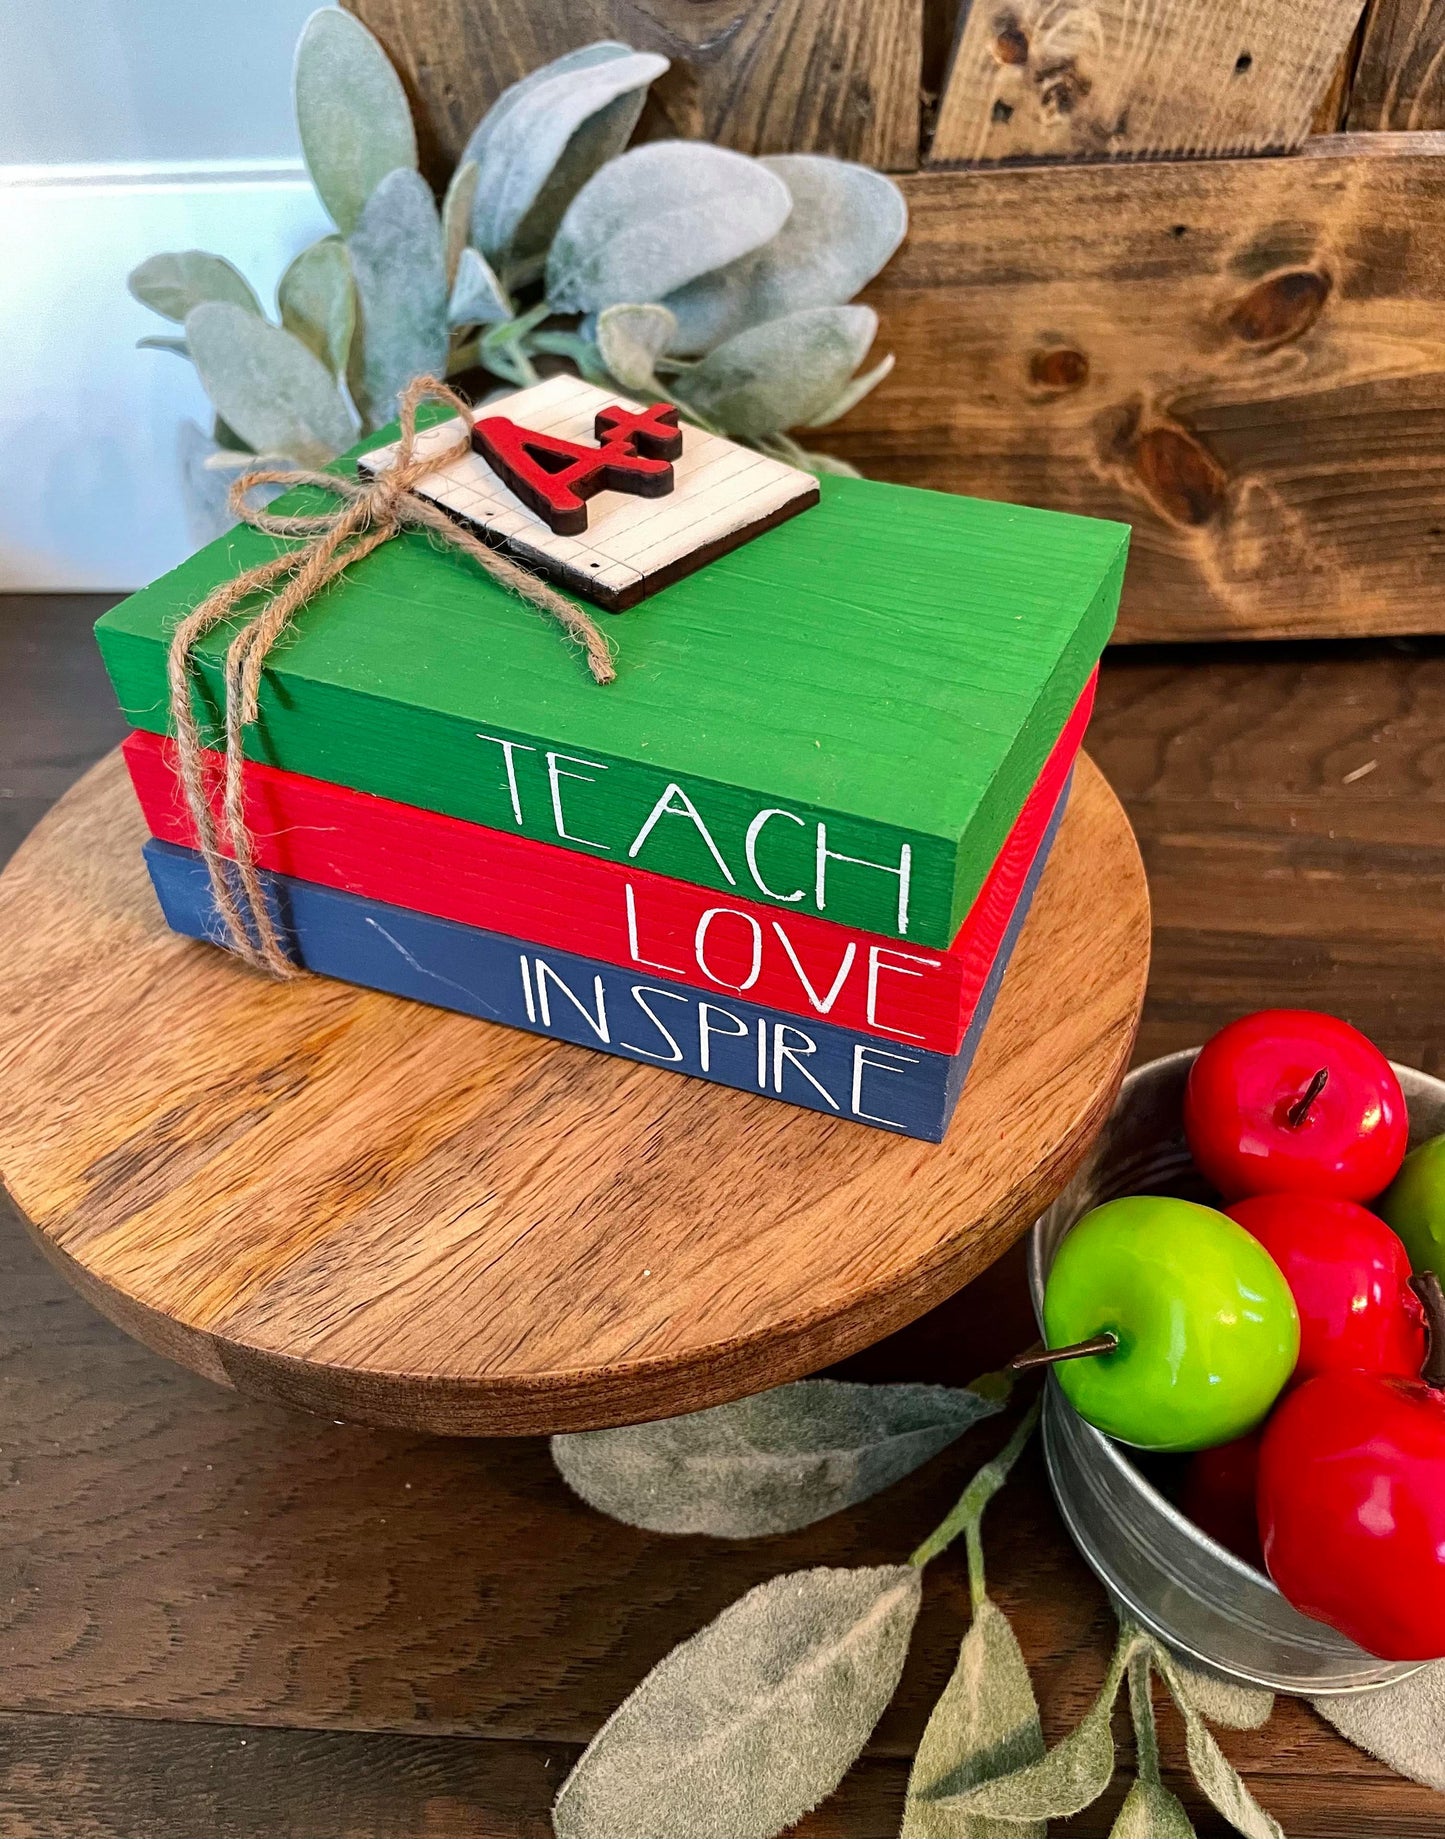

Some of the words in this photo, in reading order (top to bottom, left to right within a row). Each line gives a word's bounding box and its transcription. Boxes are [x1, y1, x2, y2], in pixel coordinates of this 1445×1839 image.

[476, 733, 912, 935] TEACH
[519, 954, 920, 1129] INSPIRE
[625, 883, 942, 1040] LOVE
